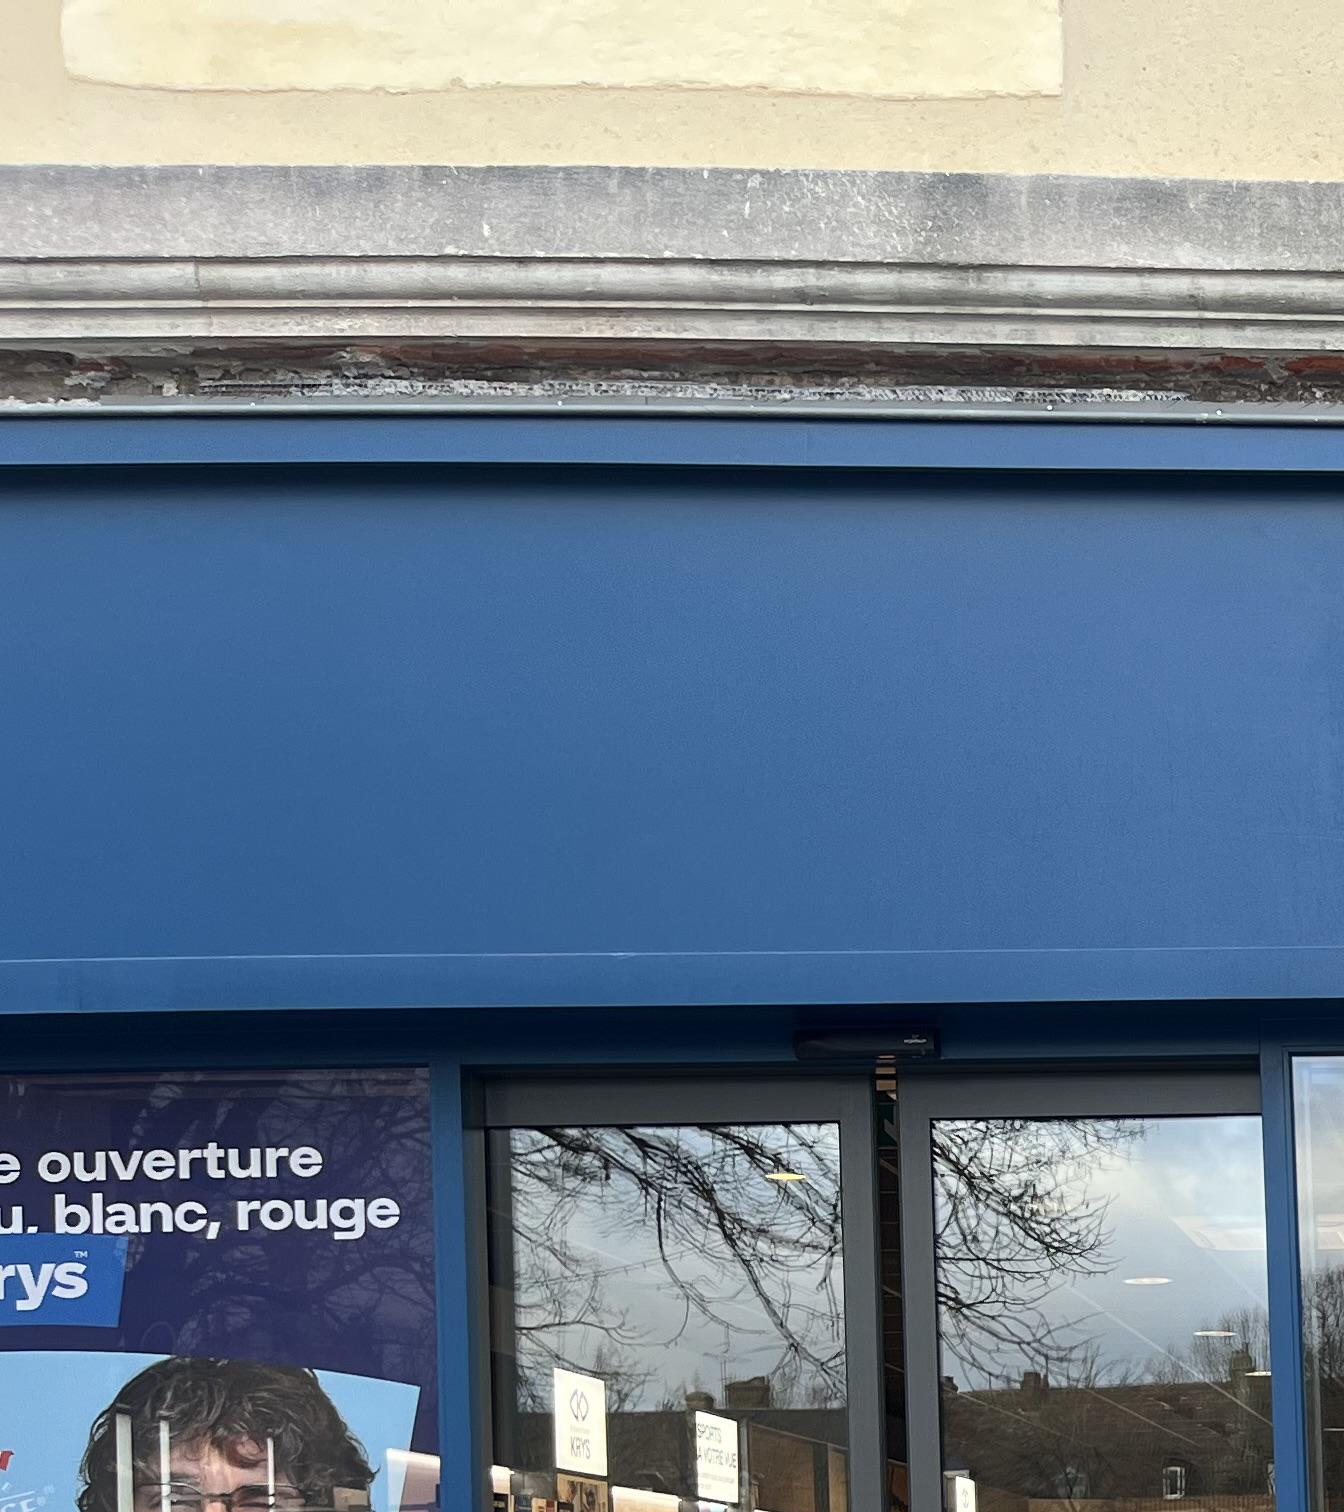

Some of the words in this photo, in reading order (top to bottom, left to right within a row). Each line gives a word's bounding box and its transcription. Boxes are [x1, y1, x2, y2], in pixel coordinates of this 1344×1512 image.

[38, 1143, 323, 1184] ouverture
[54, 1193, 219, 1240] blanc,
[237, 1197, 400, 1240] rouge
